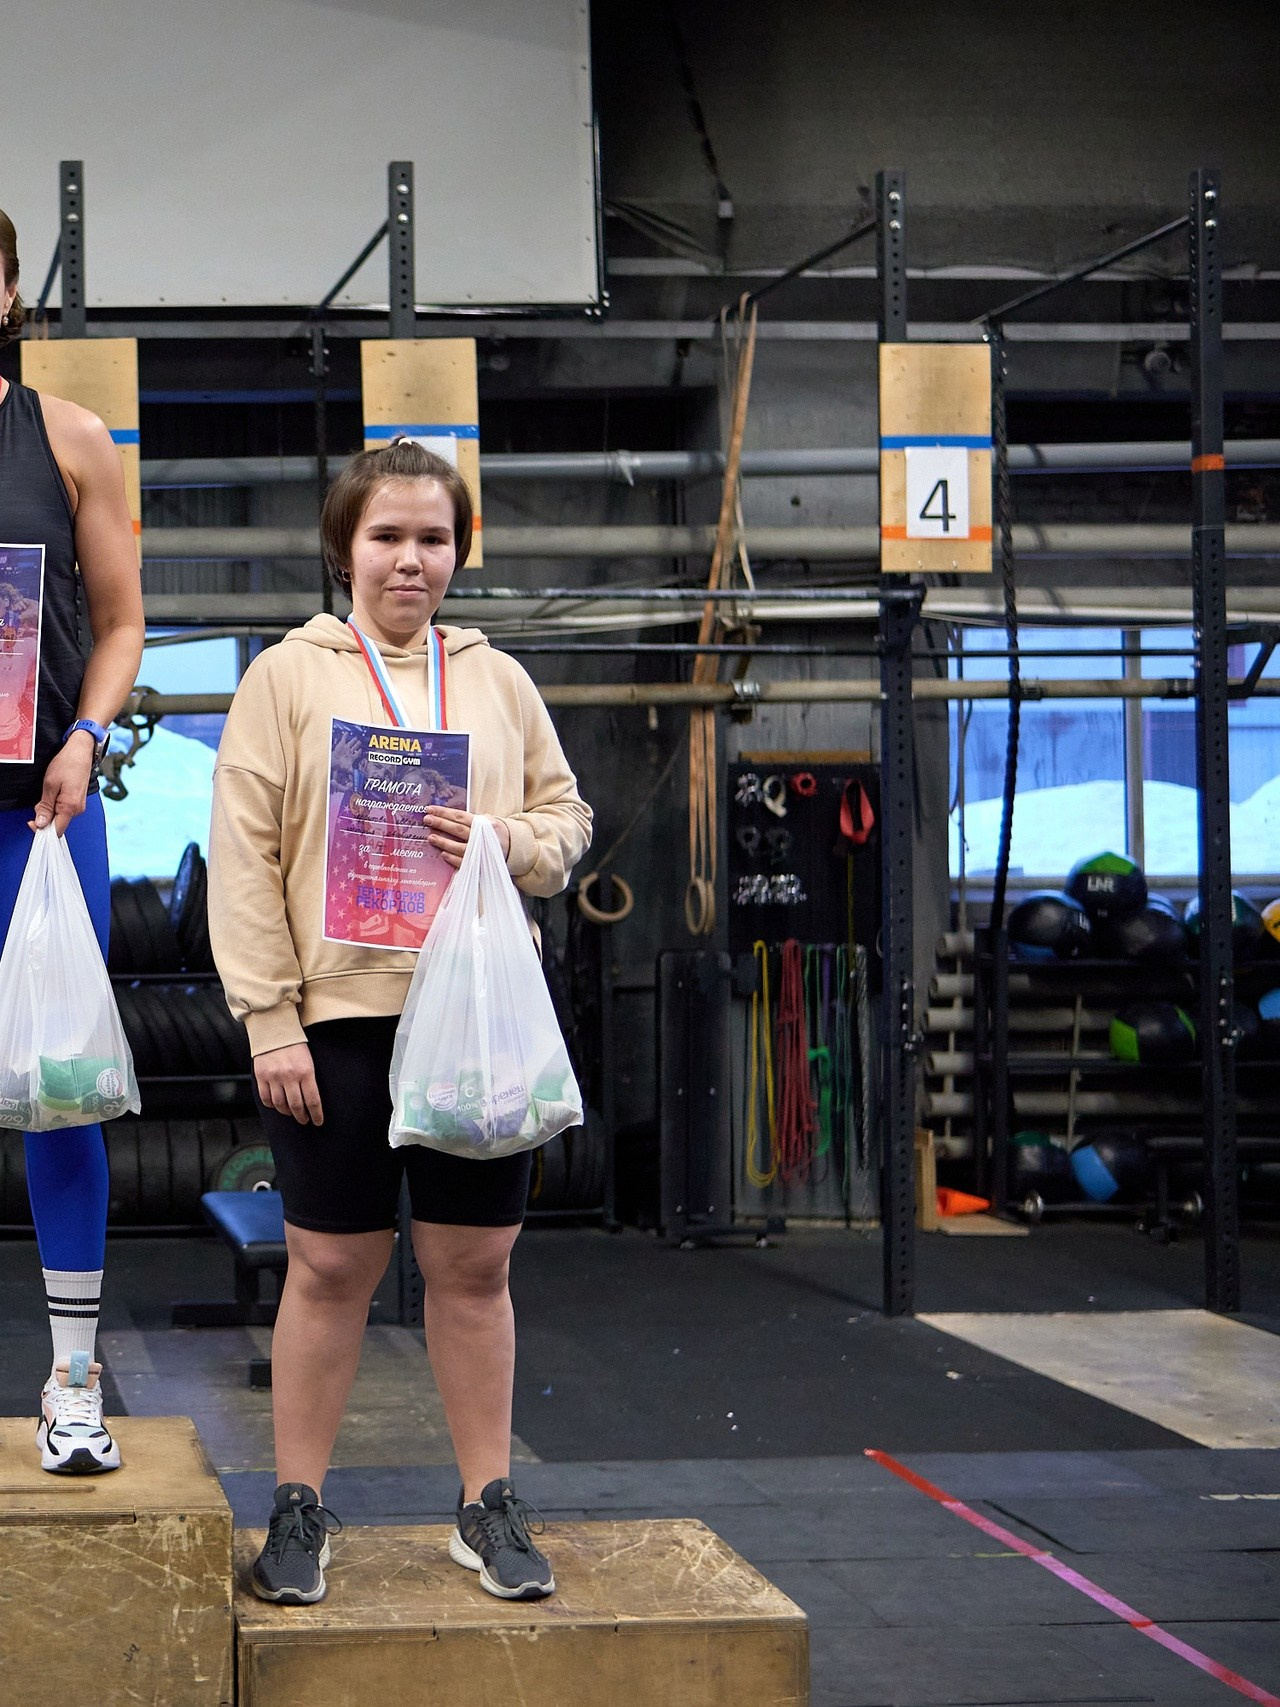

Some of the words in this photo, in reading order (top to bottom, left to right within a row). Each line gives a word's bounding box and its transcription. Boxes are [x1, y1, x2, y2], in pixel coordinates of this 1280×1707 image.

[919, 479, 956, 532] 4
[368, 734, 422, 752] ARENA
[370, 754, 401, 764] RECORD
[364, 778, 422, 796] ГРАМОТА
[358, 844, 370, 857] за
[390, 848, 424, 858] место
[358, 885, 425, 901] ТЕРРИТОРИЯ
[356, 896, 425, 914] РЕКОРДОВ
